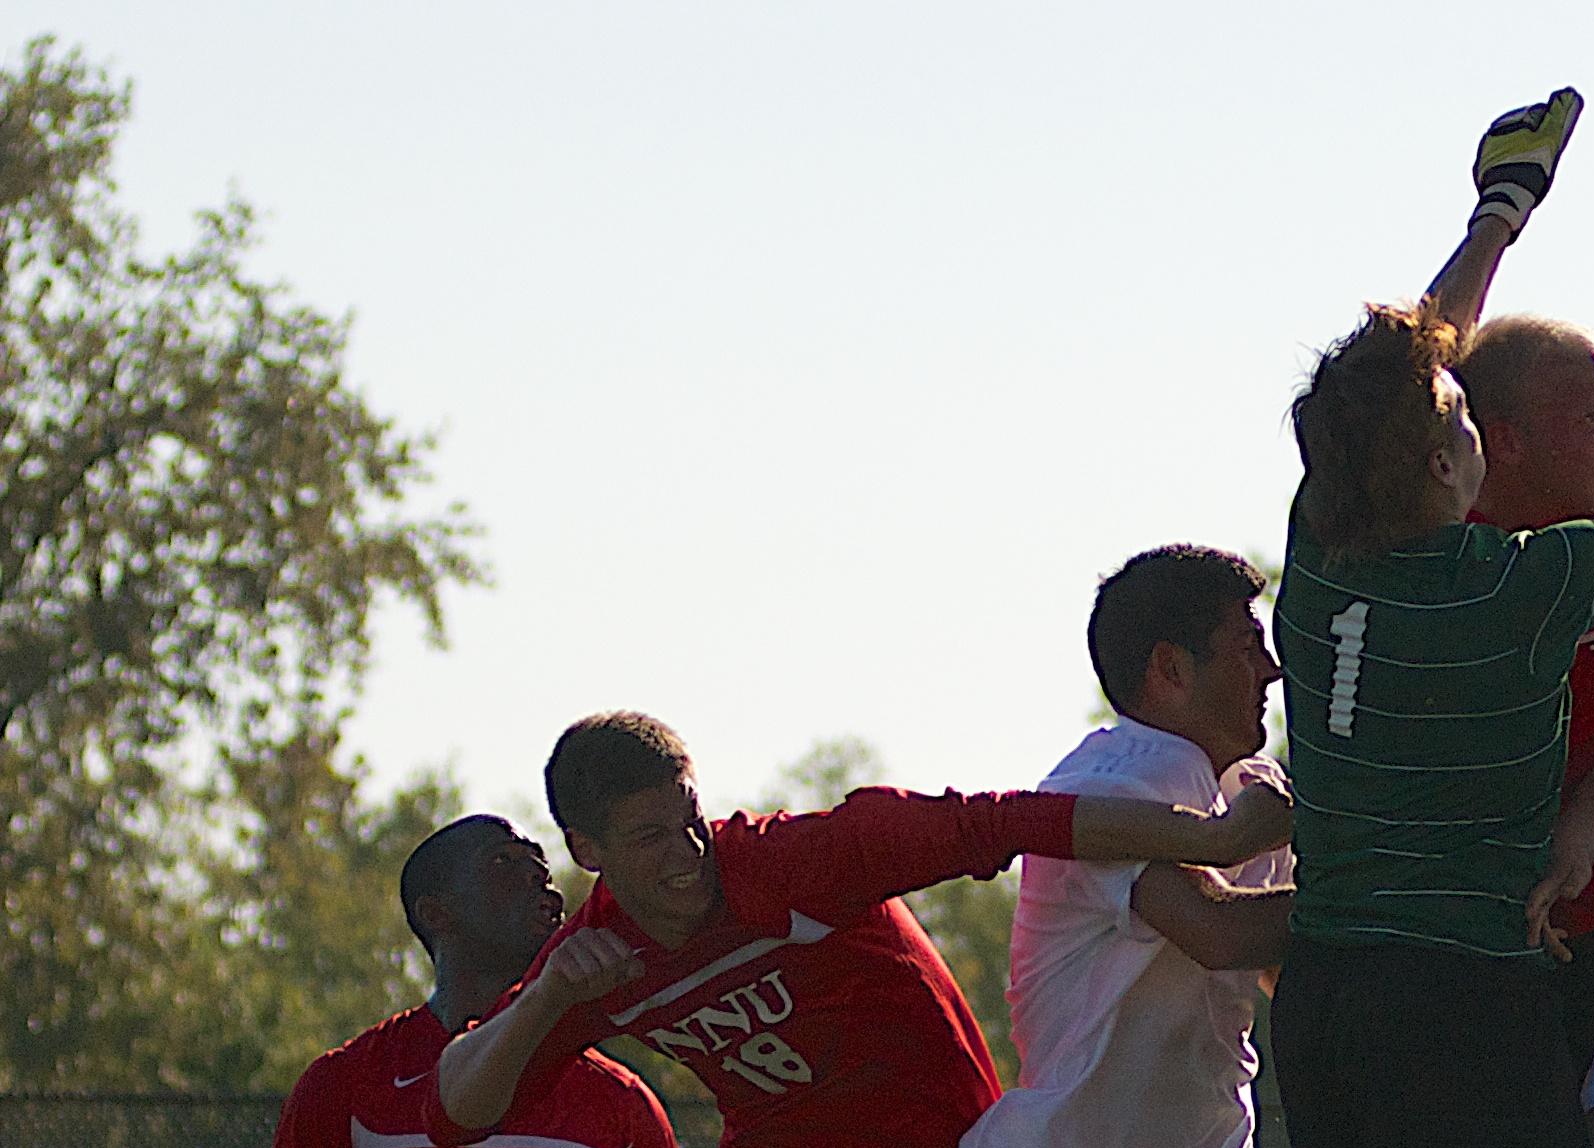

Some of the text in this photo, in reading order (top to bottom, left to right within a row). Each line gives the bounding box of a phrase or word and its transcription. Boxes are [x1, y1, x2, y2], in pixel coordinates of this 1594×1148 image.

[1328, 601, 1371, 738] 1
[645, 970, 793, 1065] NNU
[720, 1032, 813, 1094] 18
